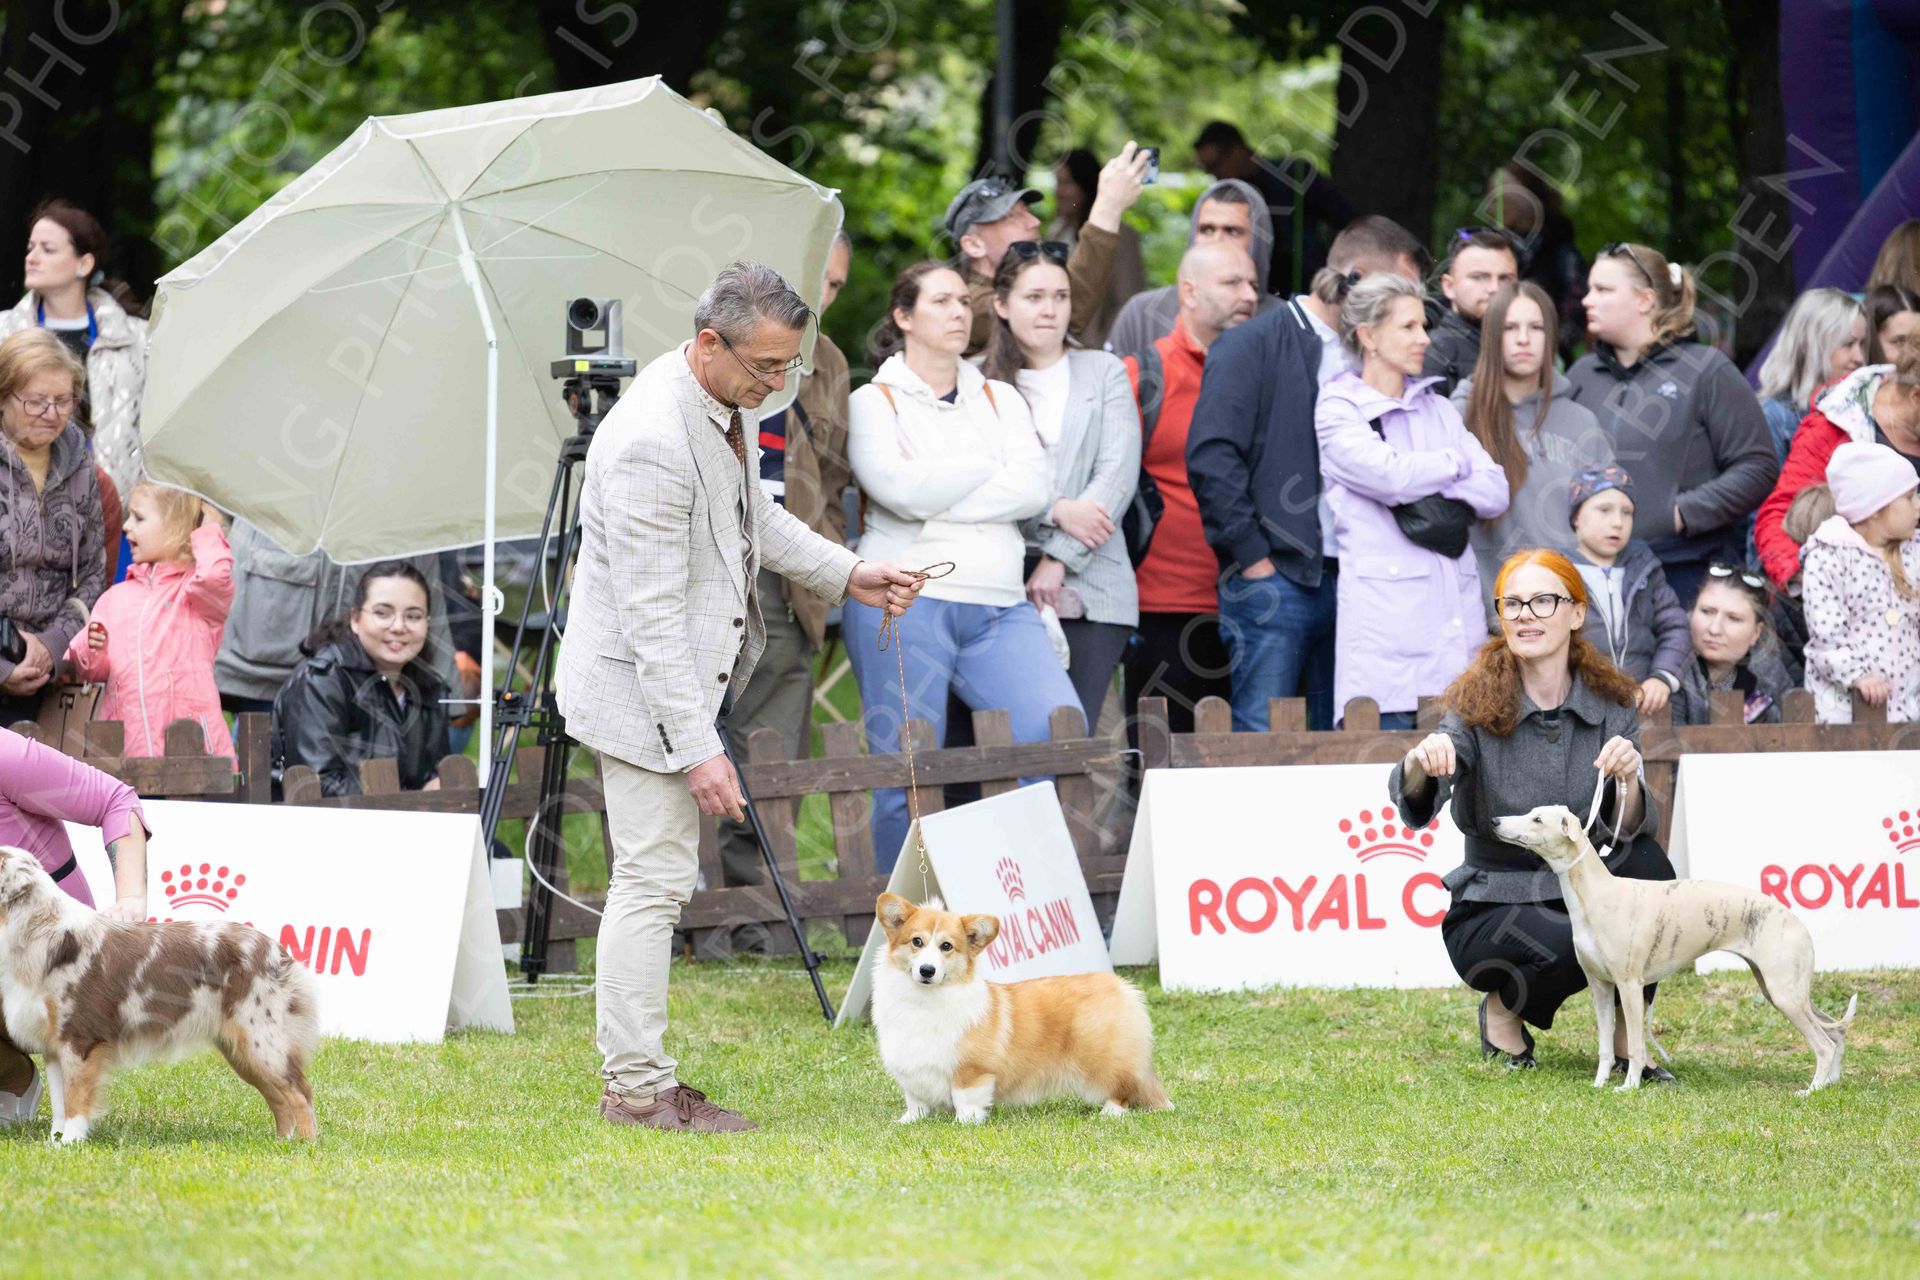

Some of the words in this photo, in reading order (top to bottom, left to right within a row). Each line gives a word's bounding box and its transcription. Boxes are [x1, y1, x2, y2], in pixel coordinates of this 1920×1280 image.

[1188, 873, 1387, 936] ROYAL
[1760, 862, 1920, 910] ROYAL
[279, 923, 371, 977] NIN
[1026, 896, 1081, 954] CANIN
